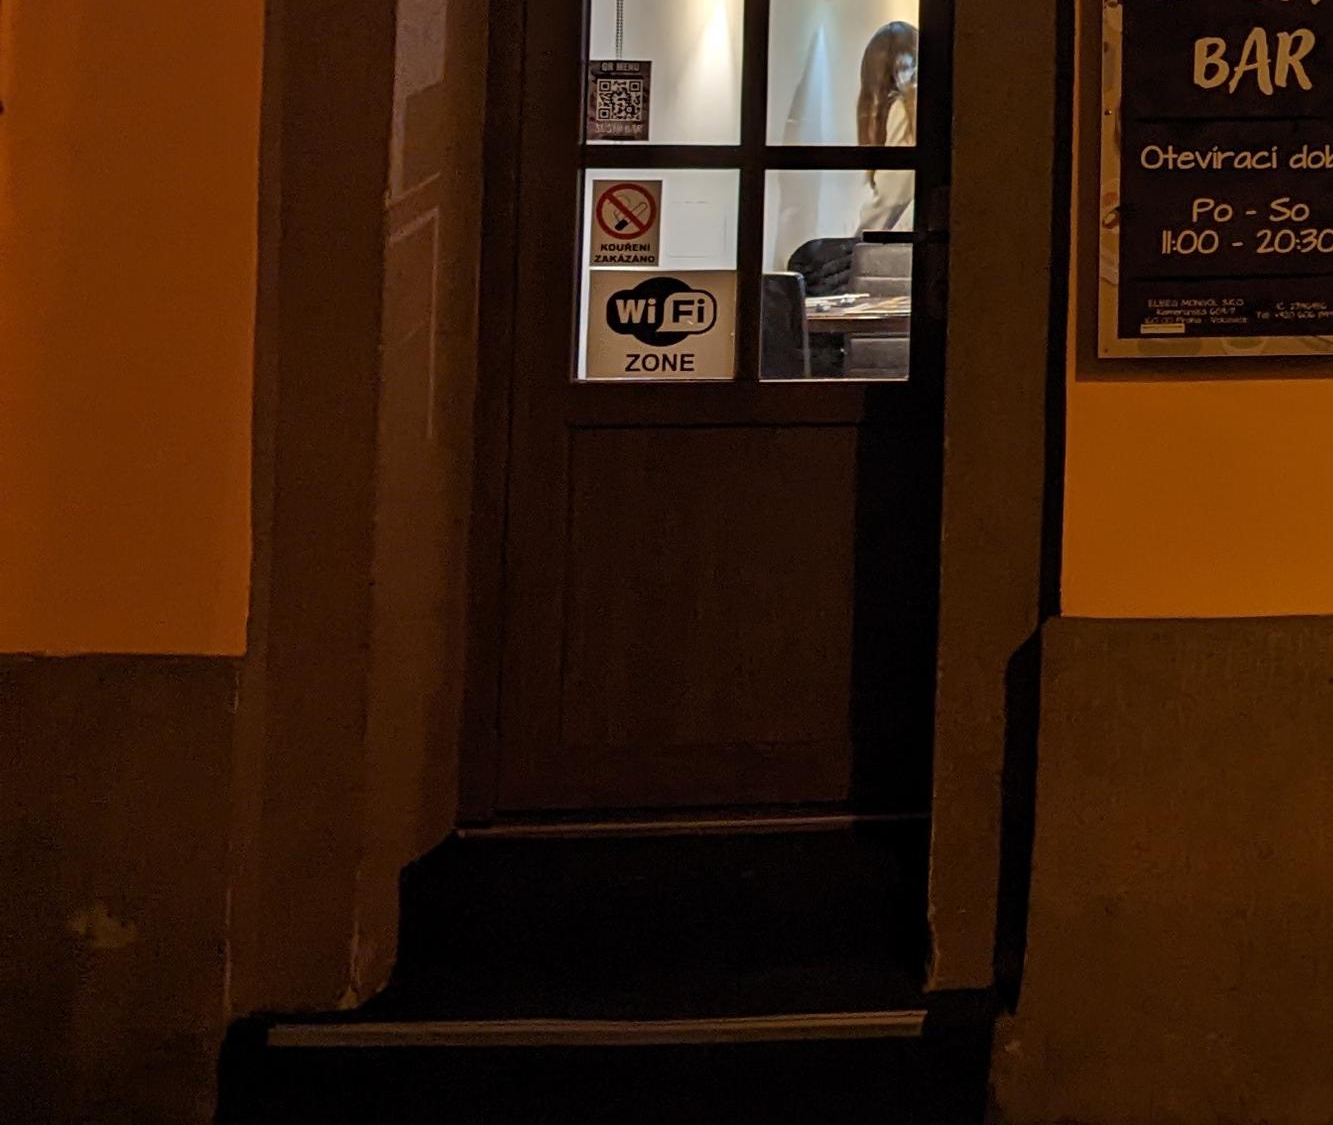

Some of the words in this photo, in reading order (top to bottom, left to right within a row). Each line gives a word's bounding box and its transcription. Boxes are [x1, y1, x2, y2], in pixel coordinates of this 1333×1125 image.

[1193, 26, 1316, 96] BAR
[1140, 145, 1278, 170] Oteviraci
[1191, 198, 1234, 223] Po
[1269, 197, 1310, 222] So
[1161, 229, 1220, 255] 11:00
[624, 353, 695, 372] ZONE
